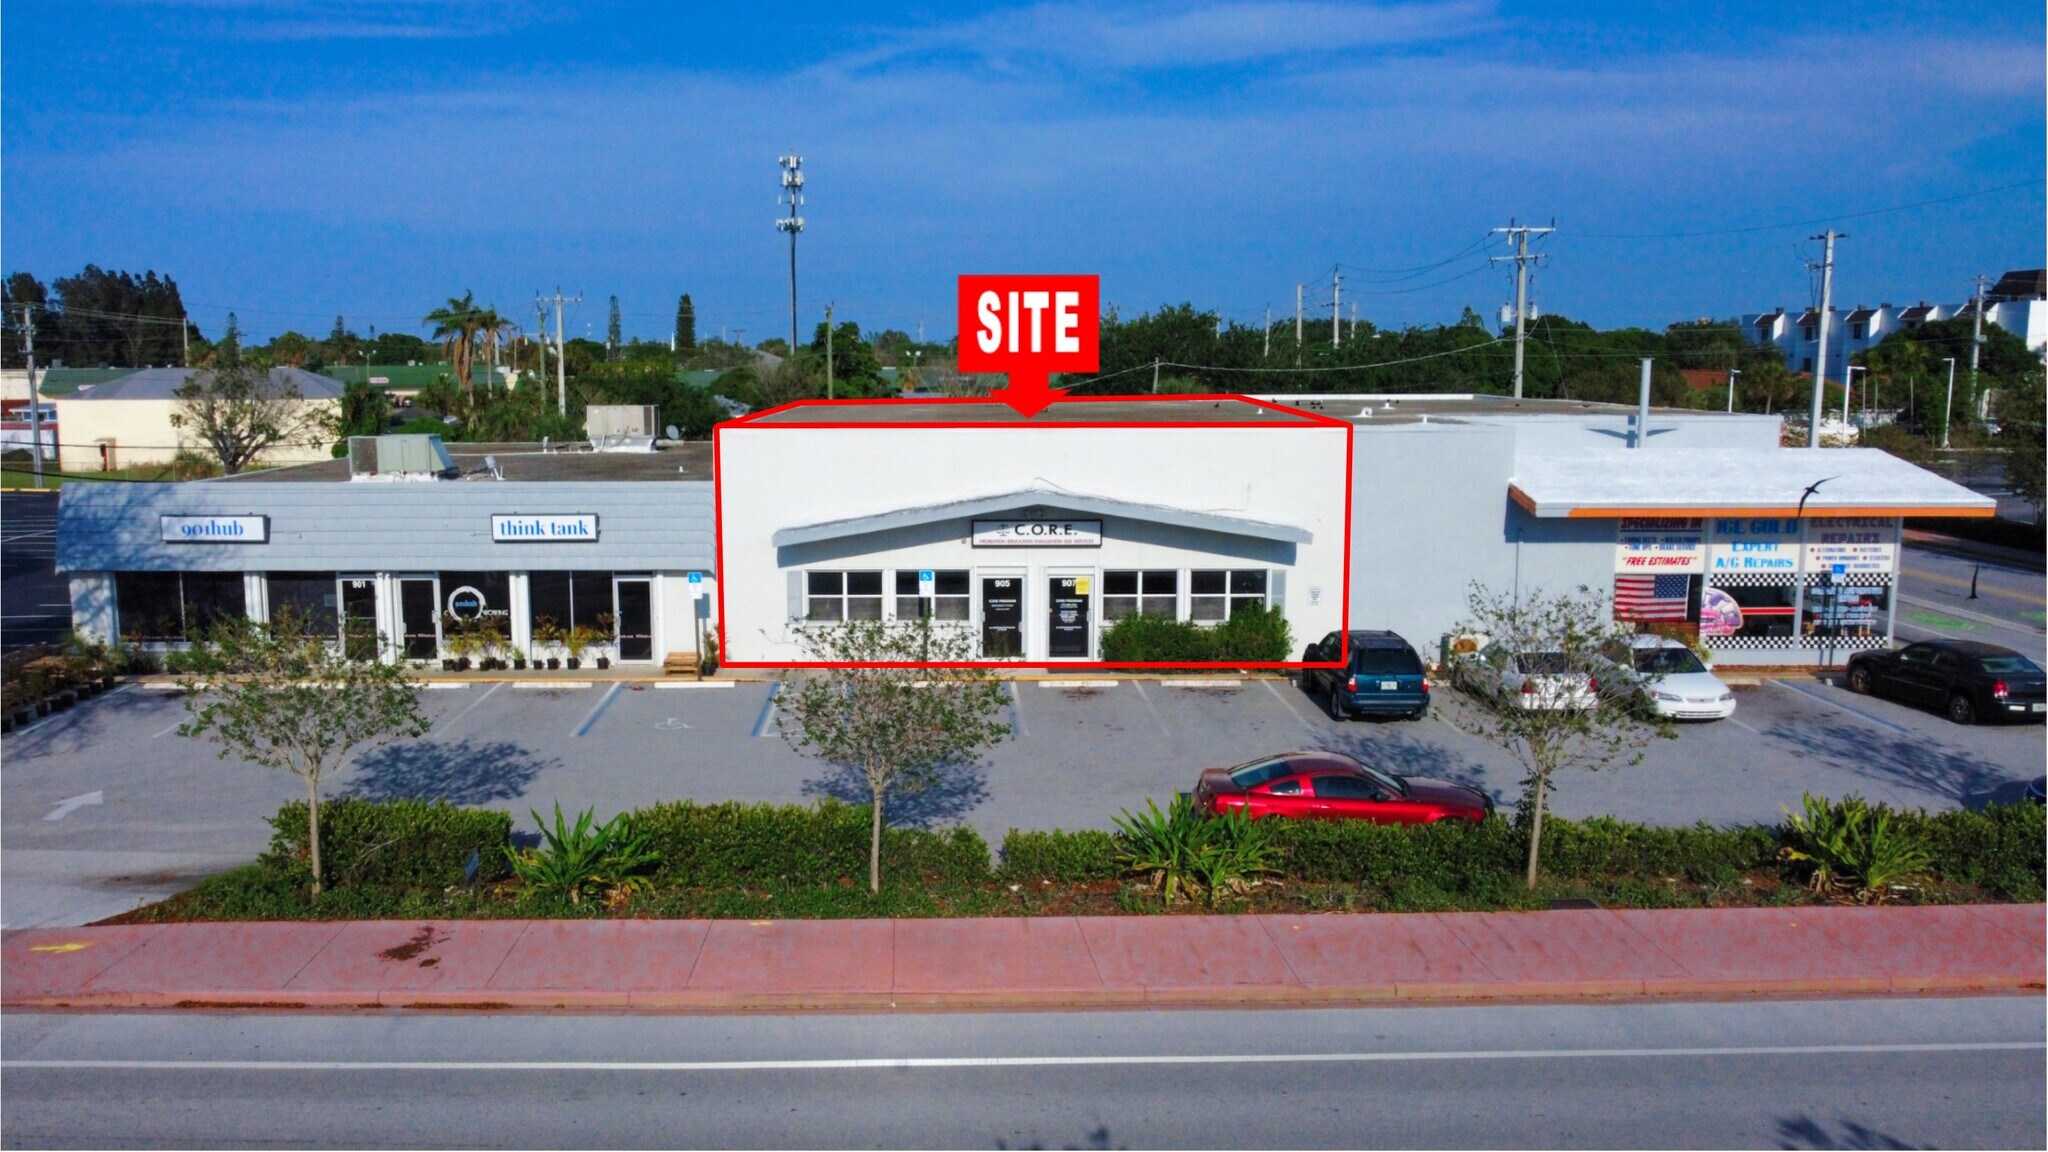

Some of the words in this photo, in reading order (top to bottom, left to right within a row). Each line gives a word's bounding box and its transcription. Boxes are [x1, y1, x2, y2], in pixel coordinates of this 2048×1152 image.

[500, 520, 546, 536] think
[551, 520, 588, 536] tank
[1809, 517, 1893, 528] ELECTRICAL
[181, 520, 244, 537] 901hub
[1014, 524, 1078, 536] C.O.R.E.
[1821, 532, 1880, 544] REPAIRS
[1732, 540, 1778, 551] EXPERT
[1744, 557, 1793, 568] REPAIRS
[352, 580, 366, 589] 901
[994, 580, 1011, 588] 905
[1061, 579, 1077, 587] 907
